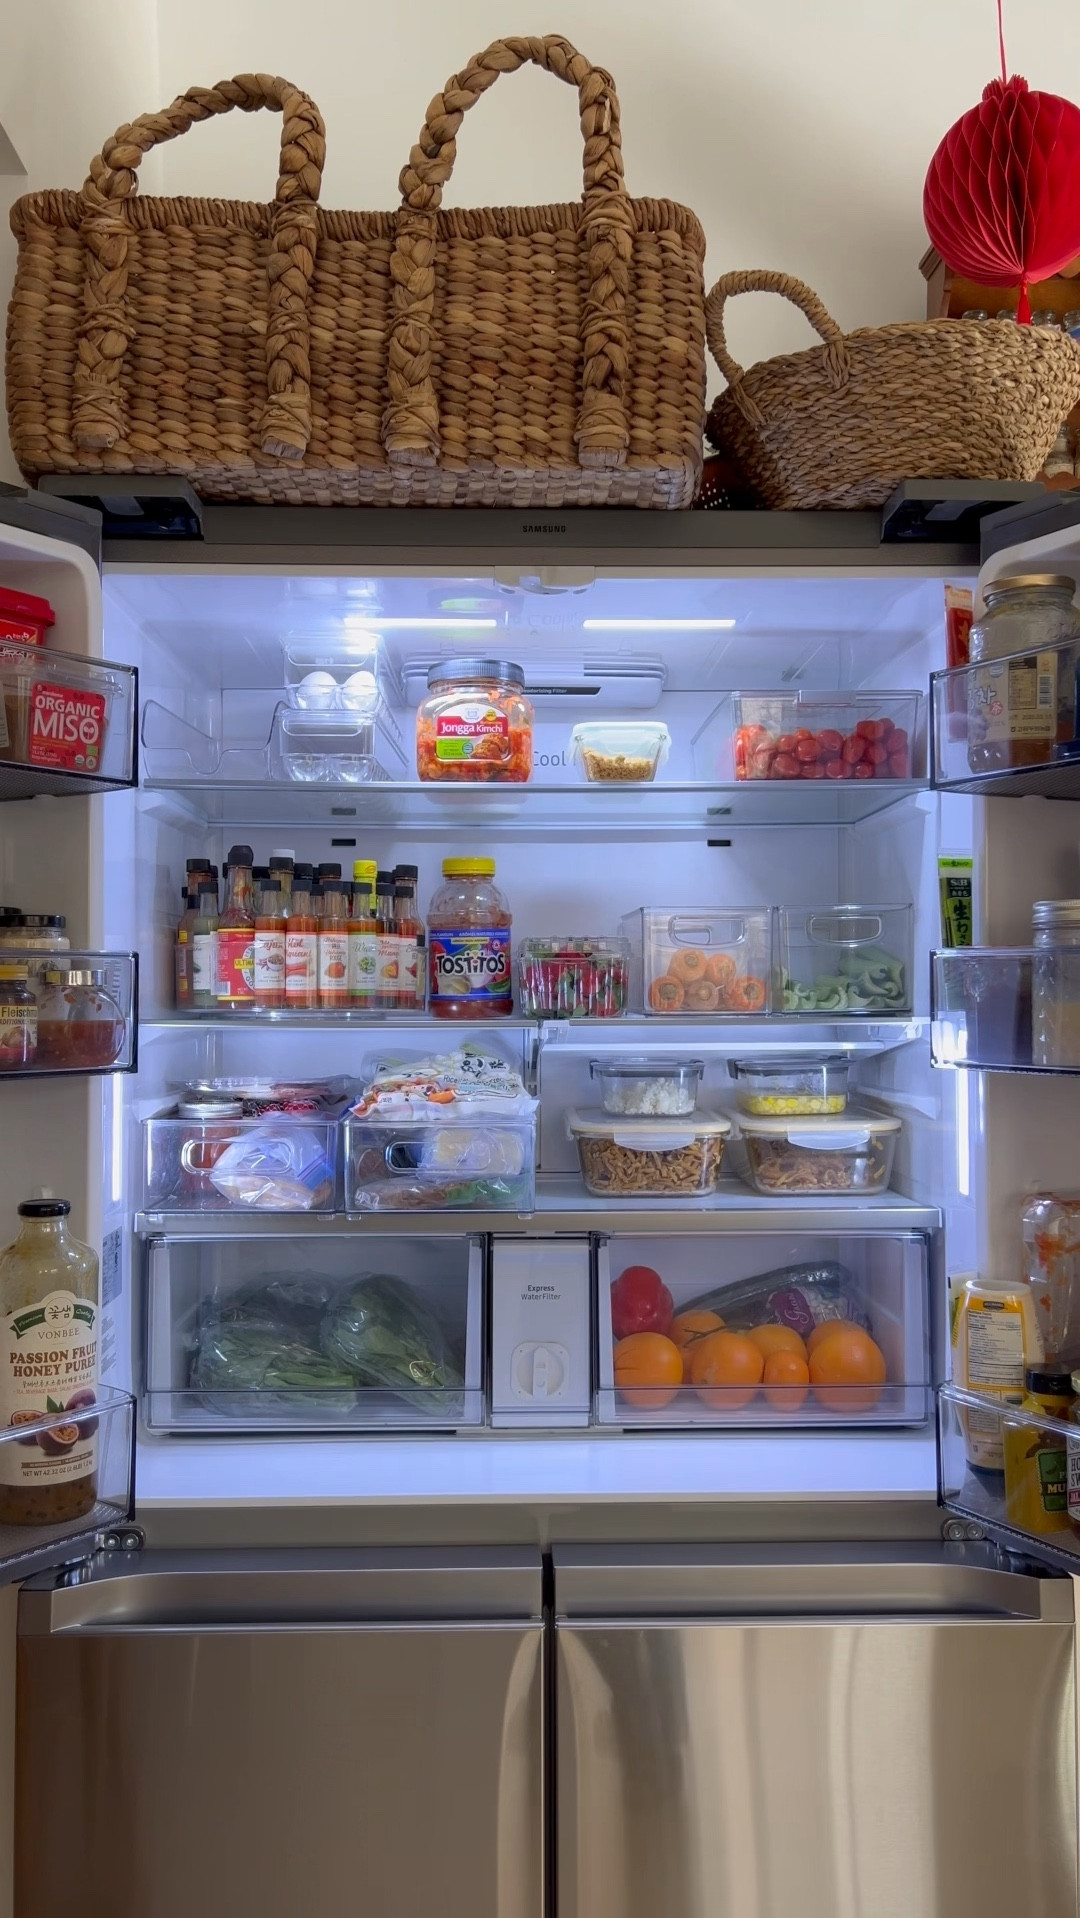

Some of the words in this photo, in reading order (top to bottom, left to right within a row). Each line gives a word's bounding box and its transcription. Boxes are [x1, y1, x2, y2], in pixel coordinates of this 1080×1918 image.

[522, 525, 566, 533] SAMSUNG
[35, 695, 100, 719] ORGANIC
[33, 708, 99, 745] MISO
[440, 721, 475, 735] Jongga
[476, 724, 503, 733] Kimchi
[527, 1284, 555, 1293] Express
[38, 1327, 80, 1340] VONBEE
[9, 1350, 69, 1364] PASSION
[72, 1341, 97, 1359] FRUIT
[13, 1364, 62, 1377] HONEY
[1047, 1483, 1066, 1494] MU
